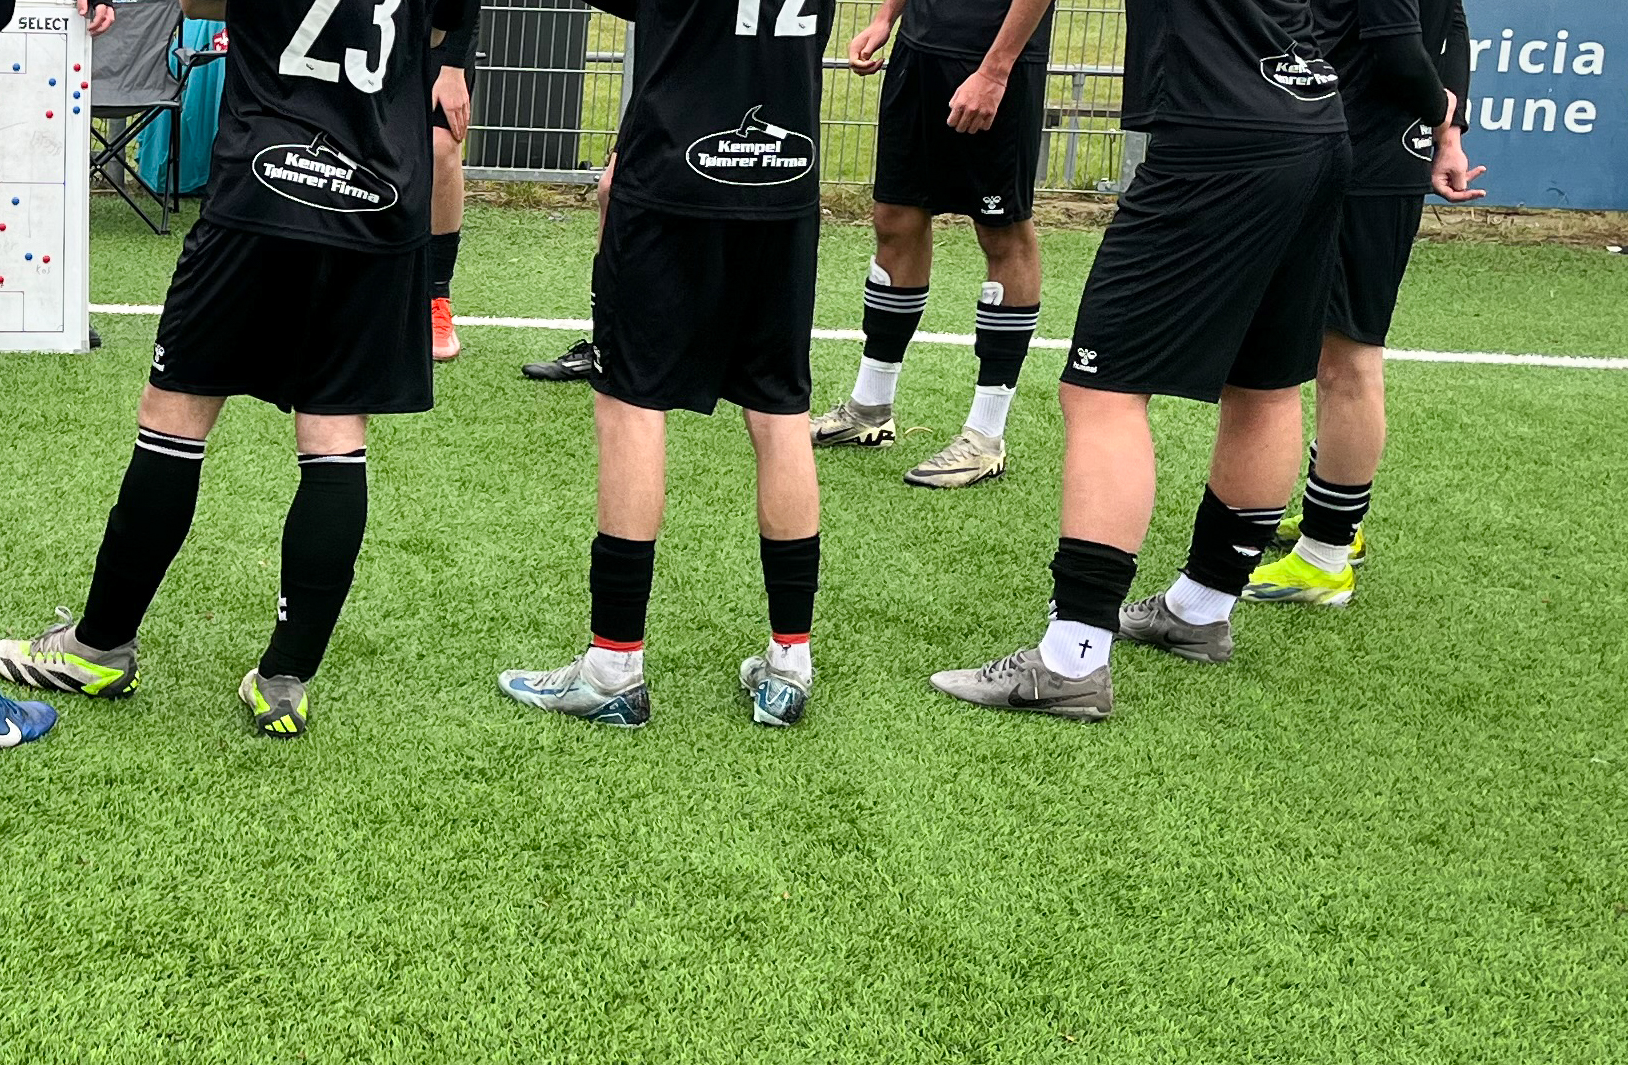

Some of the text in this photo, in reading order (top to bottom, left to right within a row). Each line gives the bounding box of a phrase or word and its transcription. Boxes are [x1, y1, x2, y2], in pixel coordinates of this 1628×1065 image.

[18, 17, 69, 31] SELECT
[718, 140, 782, 155] Kempel
[284, 151, 353, 181] Kempel
[698, 153, 808, 167] Tømrer Firma
[263, 163, 380, 204] Tømrer Firma
